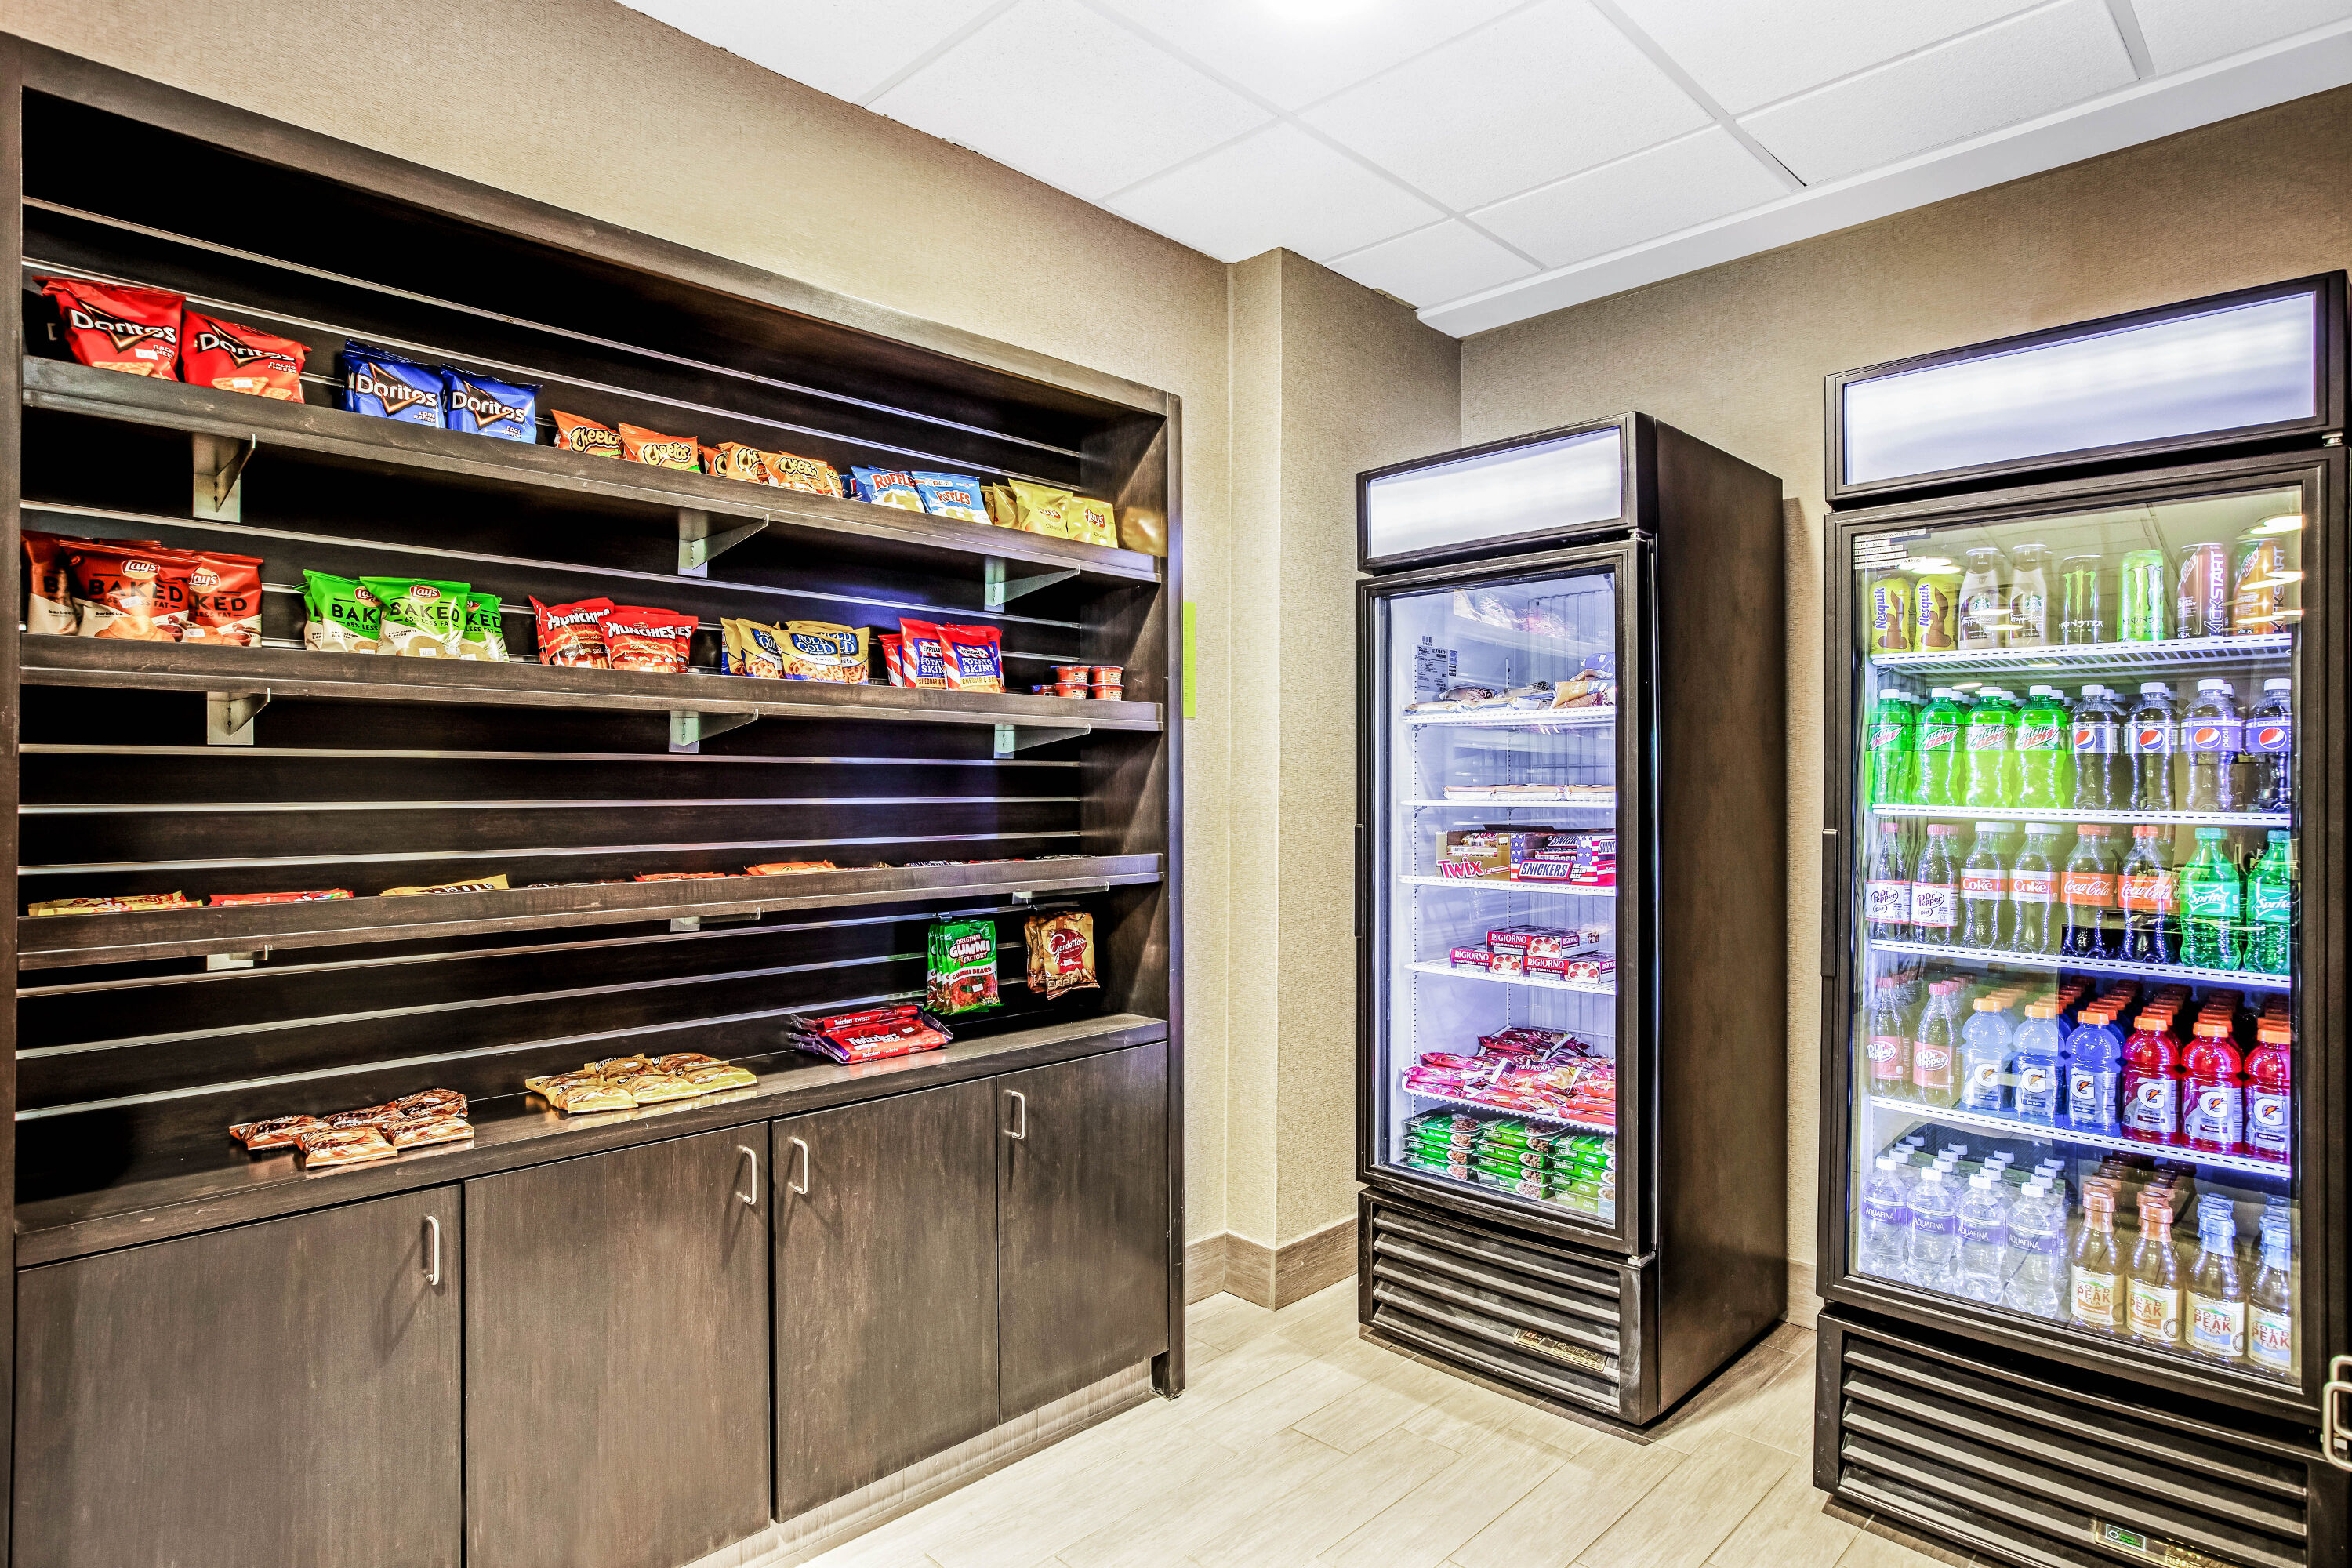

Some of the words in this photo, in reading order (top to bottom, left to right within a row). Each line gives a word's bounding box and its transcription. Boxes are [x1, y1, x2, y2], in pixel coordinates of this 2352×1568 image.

[71, 309, 176, 343] Doritos
[199, 333, 296, 361] Doritos
[268, 365, 297, 374] CHEESE
[270, 361, 296, 370] NACHO
[357, 374, 437, 408] Doritos
[452, 391, 524, 423] Doritos
[643, 443, 692, 466] Cheetos
[871, 473, 916, 490] RUFFLE
[935, 489, 973, 506] RUFFLES
[88, 579, 183, 603] BAKED
[2204, 550, 2224, 637] KICKSTART
[194, 595, 248, 612] KED
[390, 601, 460, 622] BAKED
[1874, 587, 1889, 630] Nesquik
[1919, 583, 1933, 626] Nesquik
[332, 603, 379, 625] BAK
[466, 612, 501, 628] KED
[2122, 616, 2164, 625] MONST
[361, 623, 379, 632] LESS
[606, 622, 676, 639] MUNCHIES
[2059, 619, 2103, 629] MONSTER
[797, 641, 834, 654] GOLD
[921, 665, 946, 674] SKIN
[964, 664, 996, 673] SKINS
[962, 677, 982, 685] CHEDDAR
[1549, 837, 1577, 845] SNICK
[1521, 861, 1568, 877] SNICKERS
[1962, 878, 1994, 891] Coke
[2013, 880, 2047, 894] Coke
[2064, 879, 2111, 896] Coca-Cola
[2121, 883, 2171, 900] Coca-Cola
[1871, 891, 1896, 904] Pepper
[1917, 895, 1943, 906] Pepper
[1925, 892, 1936, 901] Dr
[2190, 893, 2224, 904] Sprite
[955, 934, 982, 945] ORIGINAL
[949, 938, 991, 958] GUMMI
[963, 951, 988, 964] FACTORY
[844, 1032, 900, 1046] Twizzlers
[1867, 1044, 1893, 1060] Pepper
[1916, 1052, 1947, 1068] Pepper
[1926, 1051, 1938, 1059] Dr
[1866, 1207, 1894, 1220] AQUAFINA
[1914, 1217, 1944, 1230] AQUAFINA
[1958, 1225, 1989, 1241] AQUAFINA
[2009, 1234, 2039, 1249] AQUAFINA
[2077, 1281, 2111, 1294] GOLD
[2077, 1287, 2111, 1303] PEAK
[2129, 1293, 2162, 1307] GOLD
[2129, 1298, 2162, 1318] PEAK
[2194, 1308, 2231, 1322] GOLD
[2194, 1313, 2231, 1332] PEAK
[2252, 1321, 2290, 1338] GOLD
[2252, 1327, 2290, 1348] PEAK
